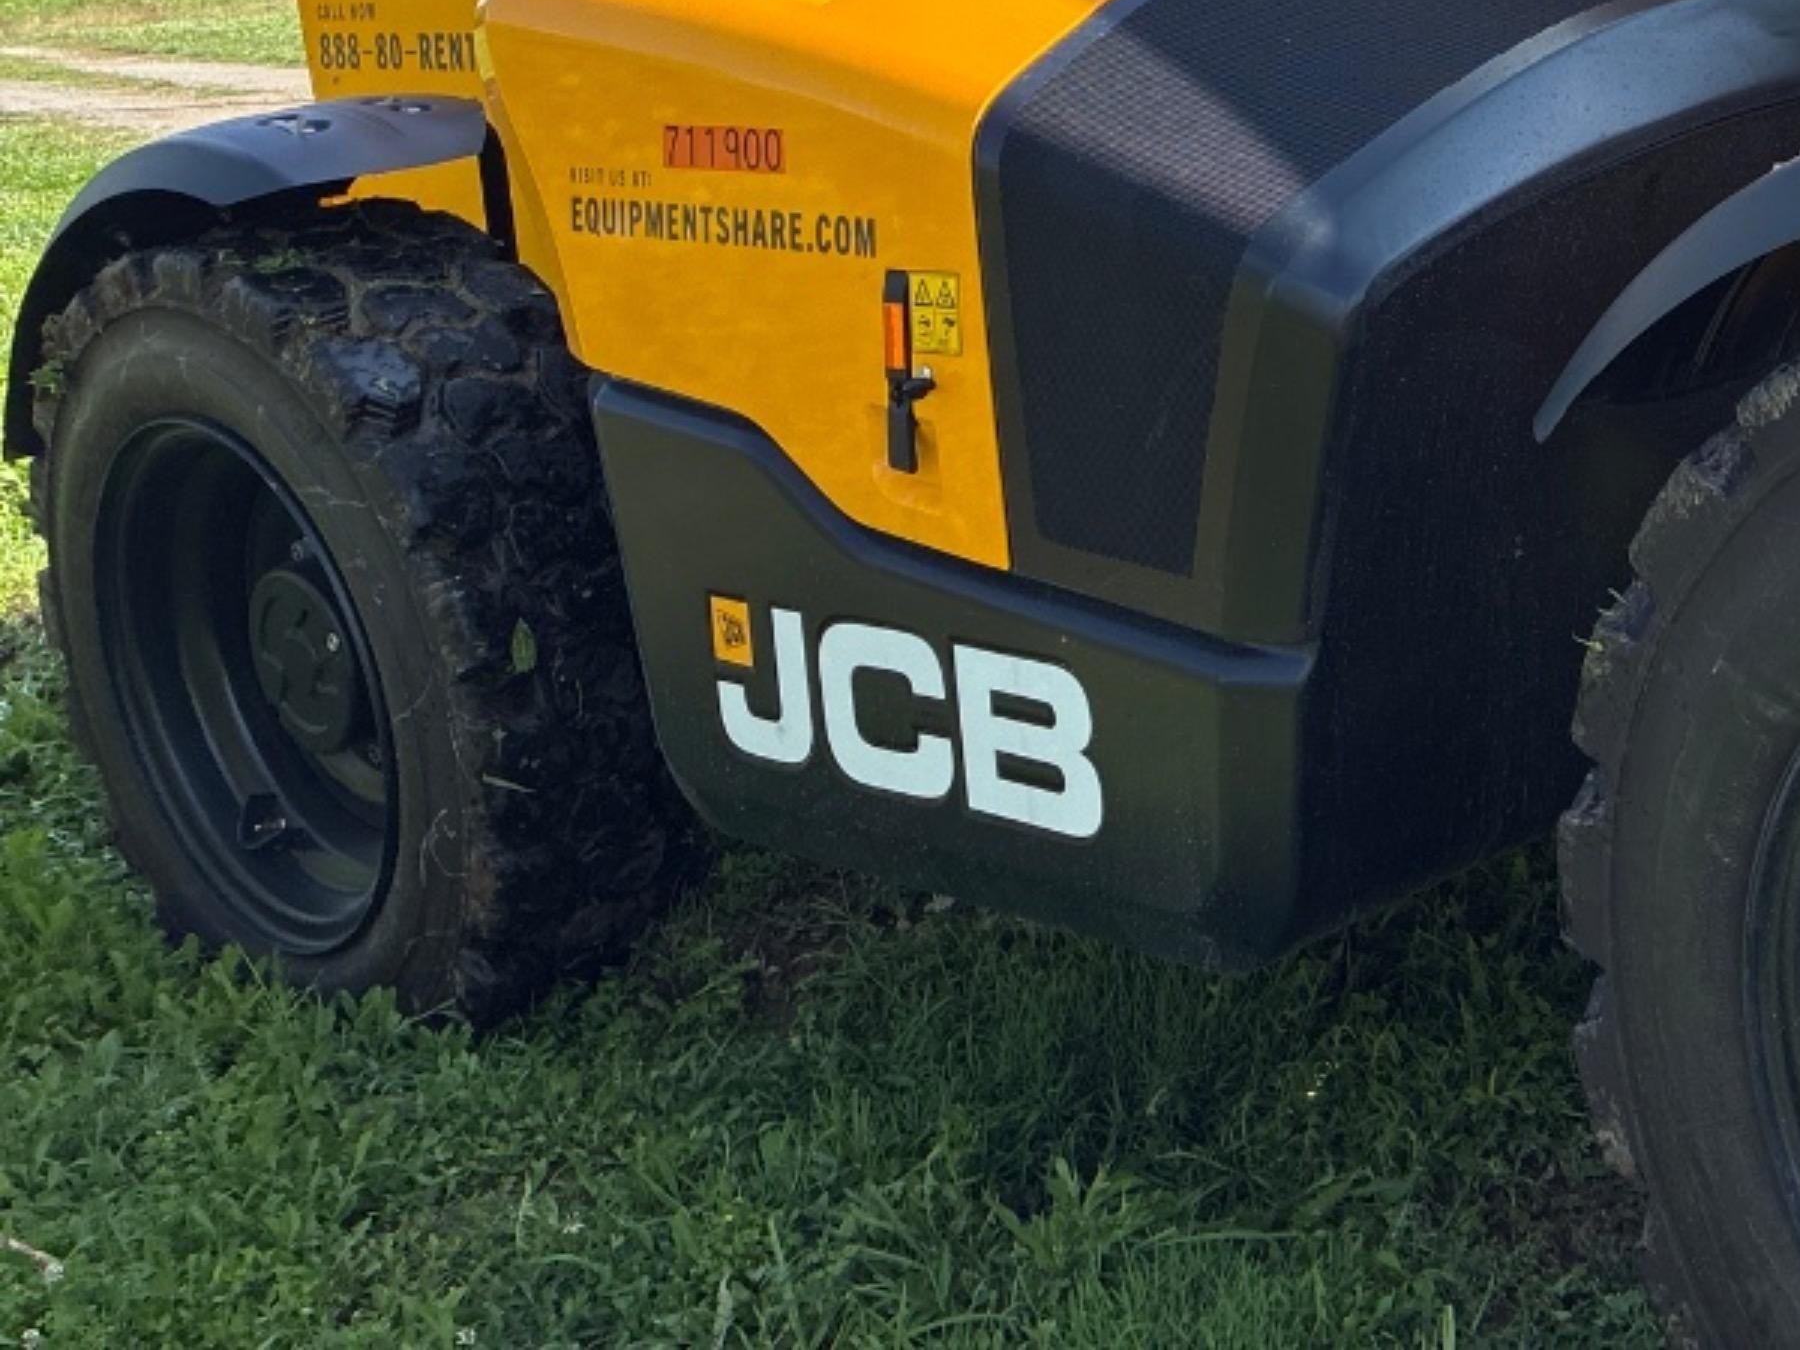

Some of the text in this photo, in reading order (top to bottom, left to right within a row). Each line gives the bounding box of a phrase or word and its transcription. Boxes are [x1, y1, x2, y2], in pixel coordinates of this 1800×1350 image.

[320, 32, 476, 72] 888-80-RENT
[665, 125, 781, 172] 711900
[571, 196, 877, 259] EQUIPMENTSHARE.COM
[717, 607, 1103, 838] JCB
